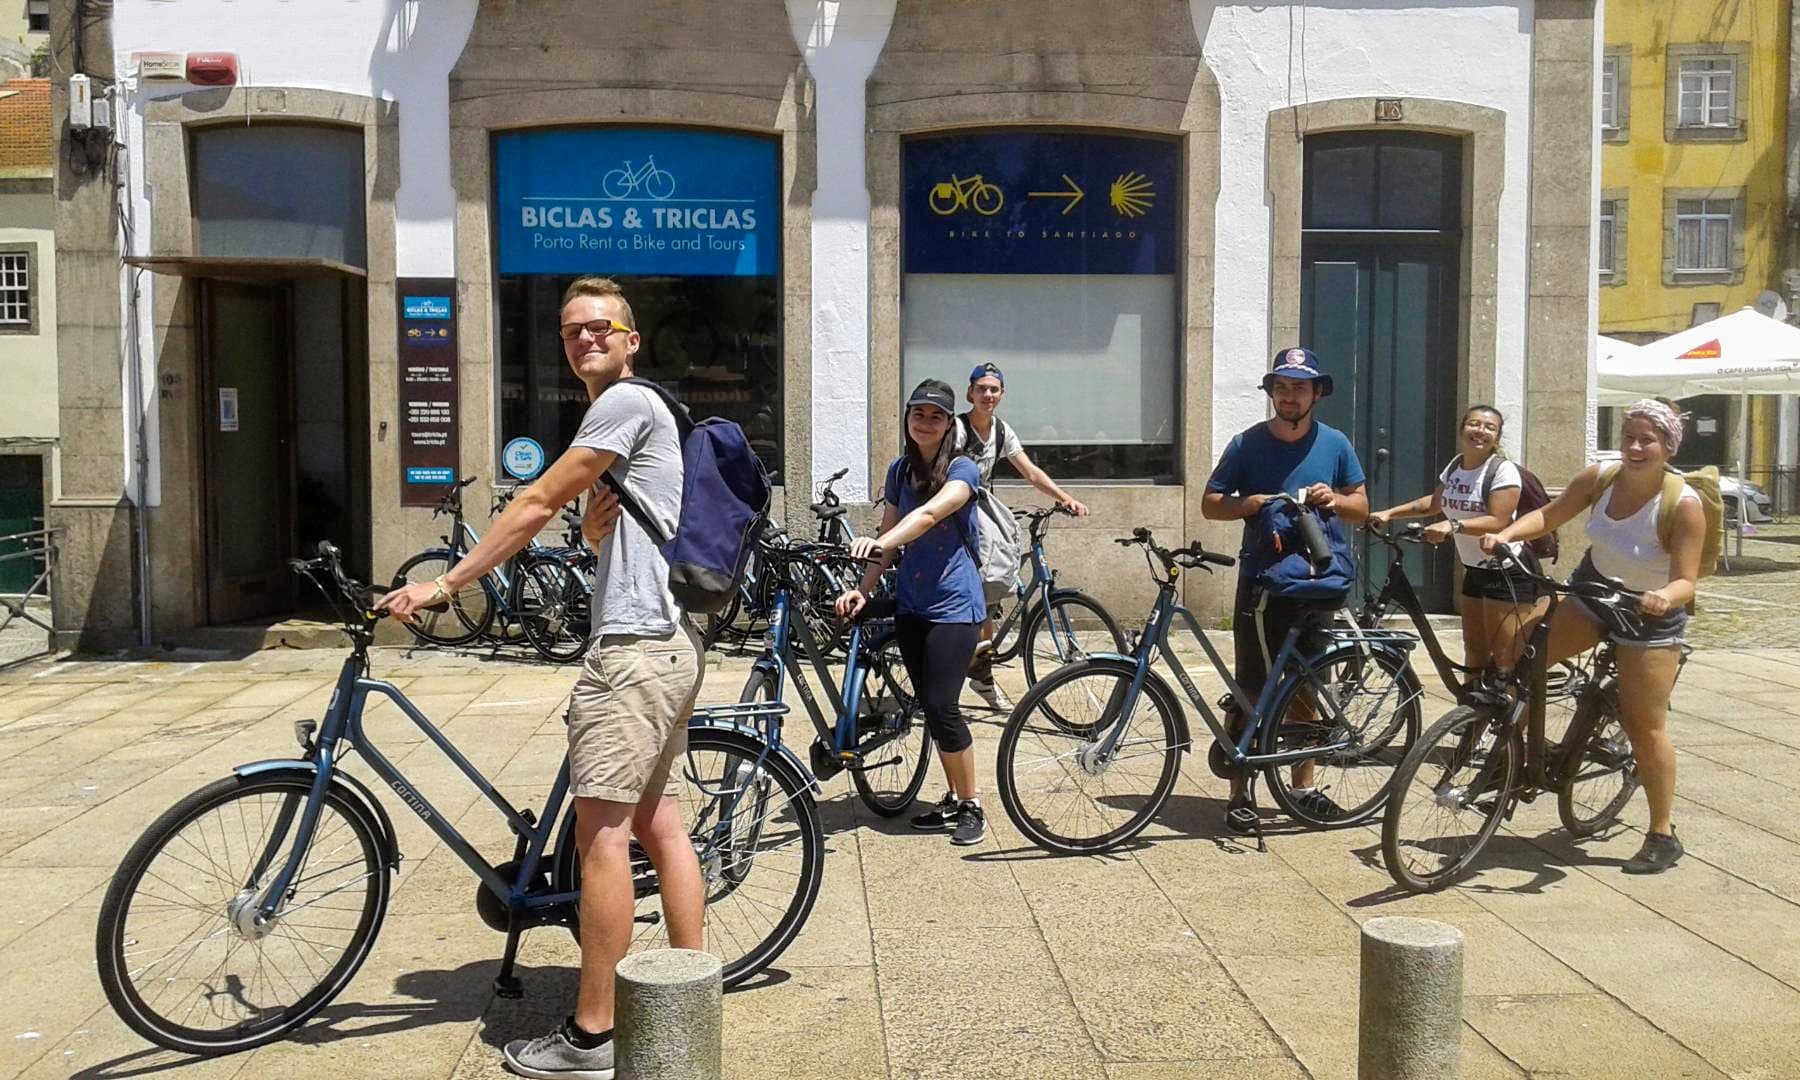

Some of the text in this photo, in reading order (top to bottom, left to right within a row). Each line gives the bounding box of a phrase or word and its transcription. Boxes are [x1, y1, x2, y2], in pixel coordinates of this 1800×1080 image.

[521, 206, 757, 230] BICLAS & TRICLAS
[534, 233, 745, 250] Porto Rent a Bike and Tours
